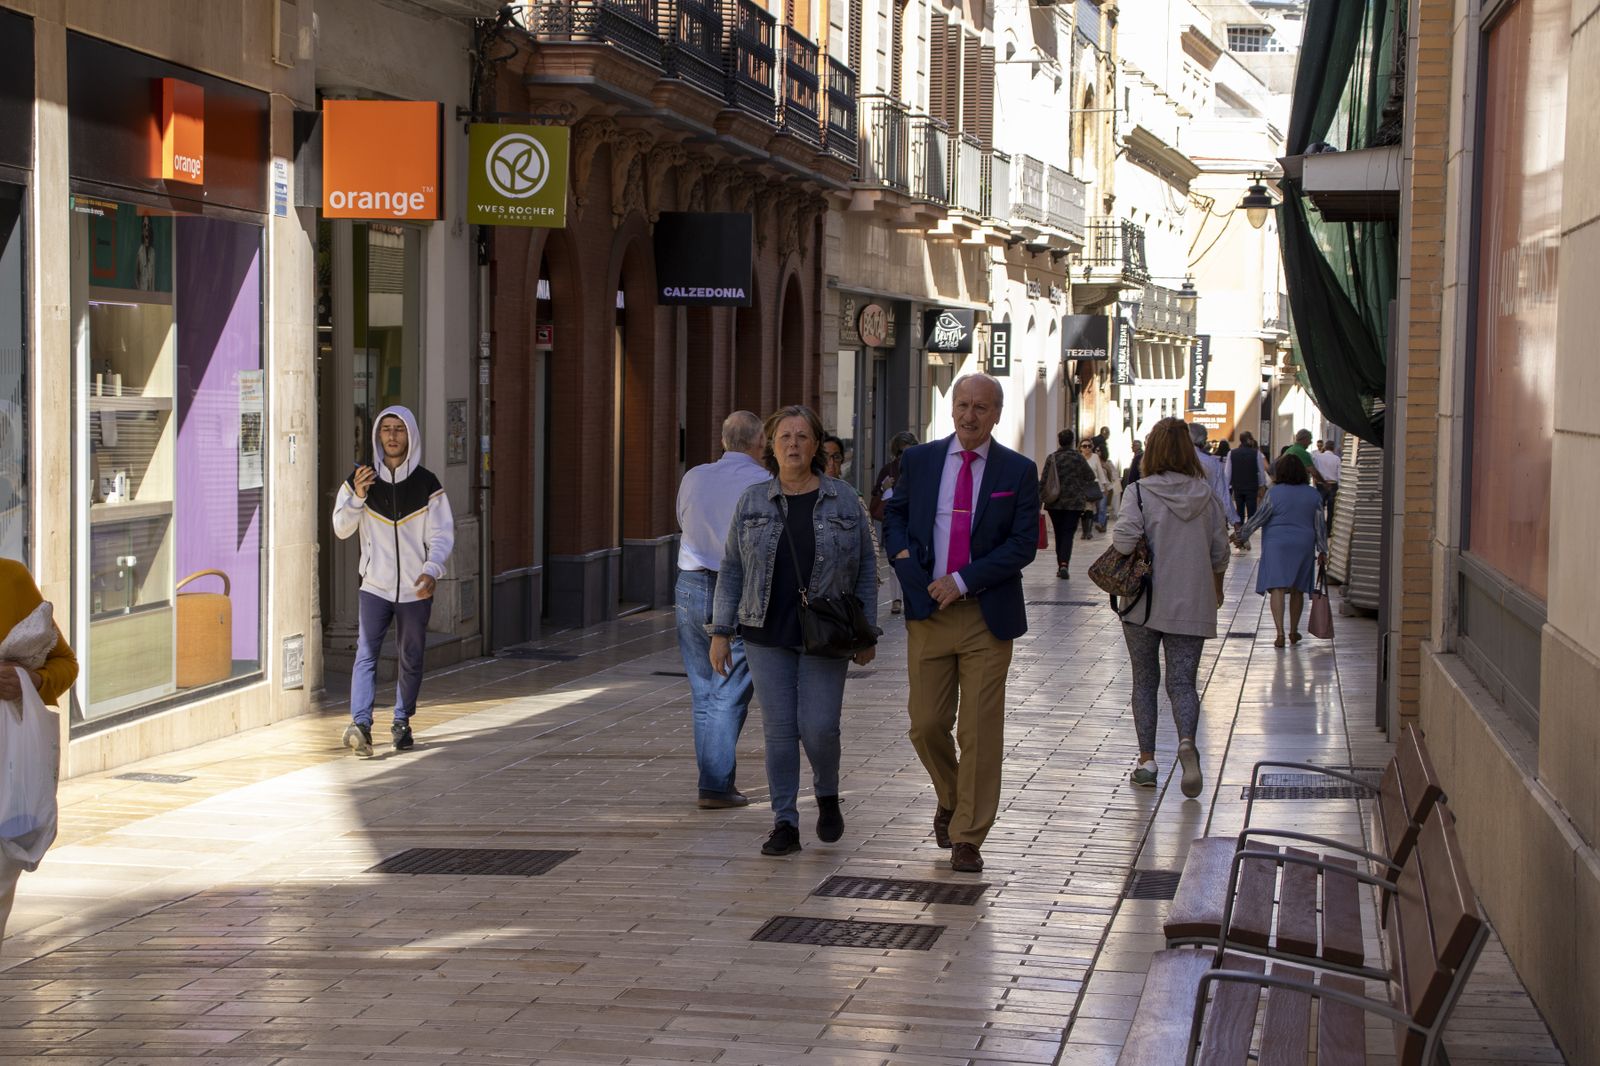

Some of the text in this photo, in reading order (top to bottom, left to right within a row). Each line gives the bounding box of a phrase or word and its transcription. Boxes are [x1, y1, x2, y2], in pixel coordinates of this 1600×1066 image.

[174, 155, 201, 179] orange
[329, 191, 435, 216] orange
[477, 204, 555, 218] YVES ROCHER
[663, 287, 746, 298] CALZEDONIA
[1119, 323, 1128, 346] ESTATE
[1118, 347, 1127, 363] REAL
